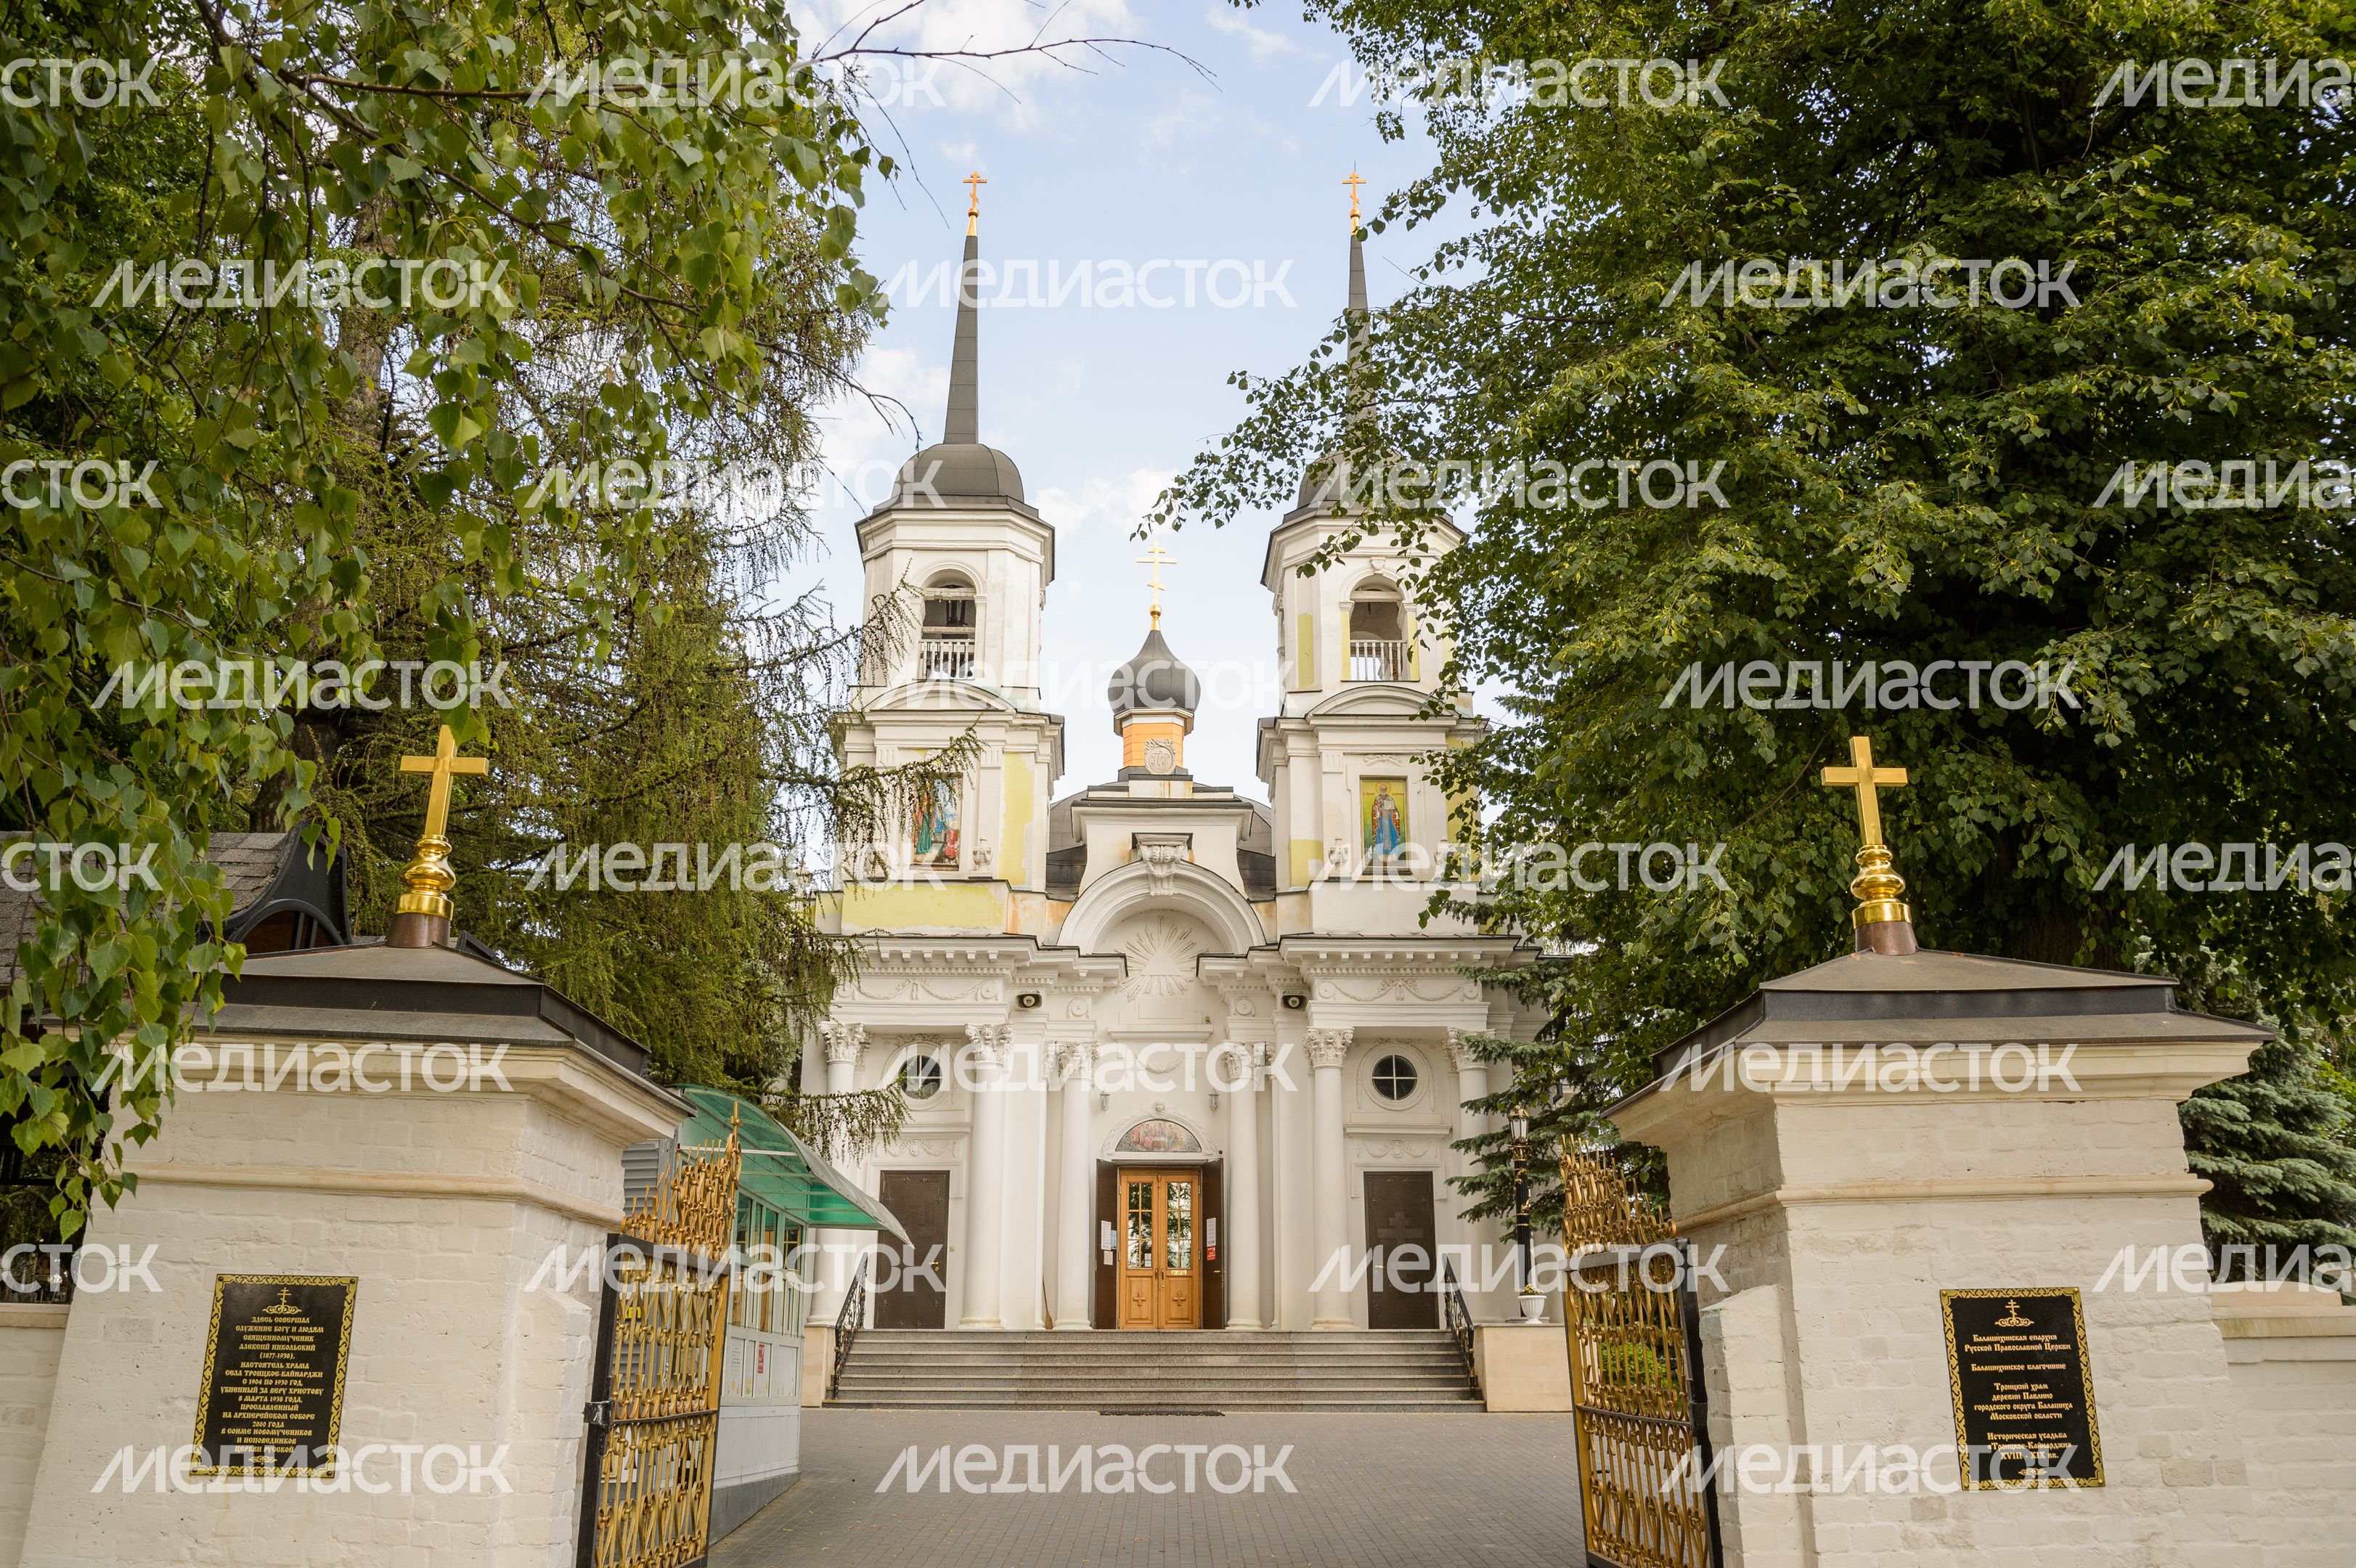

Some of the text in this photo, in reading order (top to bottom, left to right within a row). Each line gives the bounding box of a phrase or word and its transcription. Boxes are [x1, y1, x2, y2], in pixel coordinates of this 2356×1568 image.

[1973, 1334, 2027, 1343] Балашихинская
[1965, 1343, 2071, 1353] Русской Православной Церкви
[1994, 1383, 2048, 1392] Троицкий храм
[1987, 1432, 2037, 1441] Историческая
